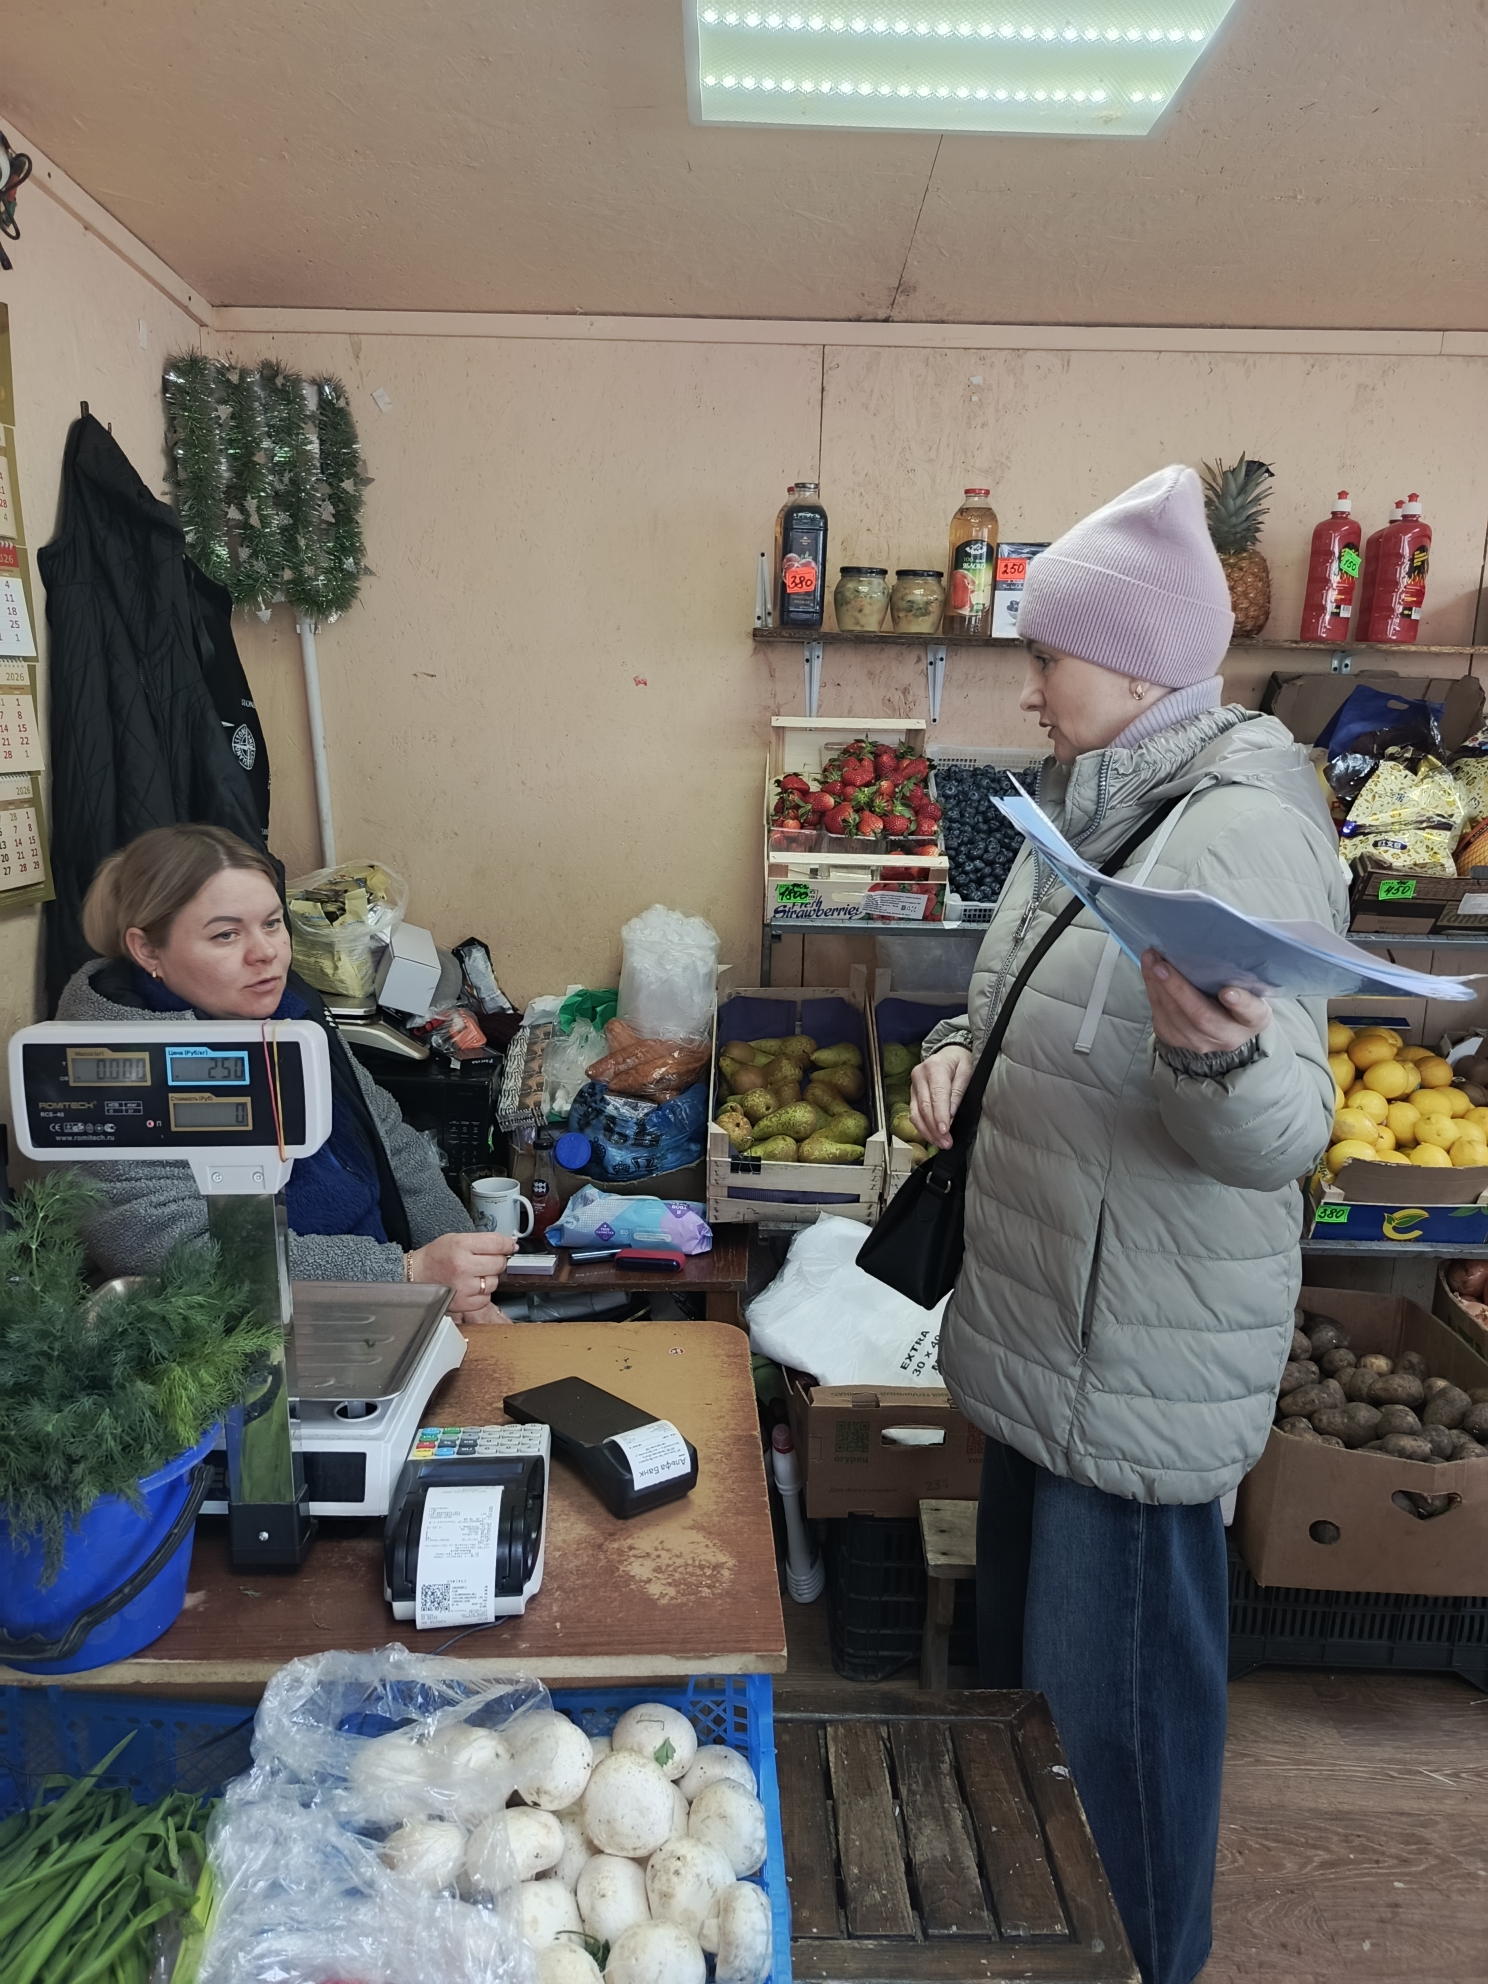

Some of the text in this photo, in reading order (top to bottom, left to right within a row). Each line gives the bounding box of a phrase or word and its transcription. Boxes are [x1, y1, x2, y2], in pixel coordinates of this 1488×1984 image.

[1002, 563, 1025, 575] 250
[1343, 559, 1357, 571] 150
[787, 575, 814, 589] 380
[5, 594, 15, 602] 11
[7, 607, 18, 616] 18
[10, 620, 20, 629] 25
[6, 673, 25, 682] 2026
[16, 698, 21, 707] 1
[17, 711, 23, 720] 8
[0, 724, 28, 733] 14 15
[2, 737, 30, 746] 21 22
[4, 751, 13, 759] 28
[16, 786, 31, 796] 2026
[25, 811, 30, 820] 1
[13, 825, 18, 834] 7
[28, 823, 33, 832] 8
[14, 838, 23, 847] 14
[29, 836, 36, 845] 15
[1, 848, 38, 862] 20 21 22
[3, 861, 40, 876] 27 28 29
[779, 887, 809, 901] 1800
[1384, 885, 1411, 896] 450
[773, 904, 863, 920] Strawberries
[208, 1058, 245, 1079] 250
[236, 1103, 245, 1124] 0
[1318, 1208, 1345, 1219] 380
[900, 1331, 930, 1370] EXTRA
[912, 1361, 926, 1377] 30
[834, 1457, 869, 1465] огурец
[639, 1457, 687, 1477] Альфа Банк
